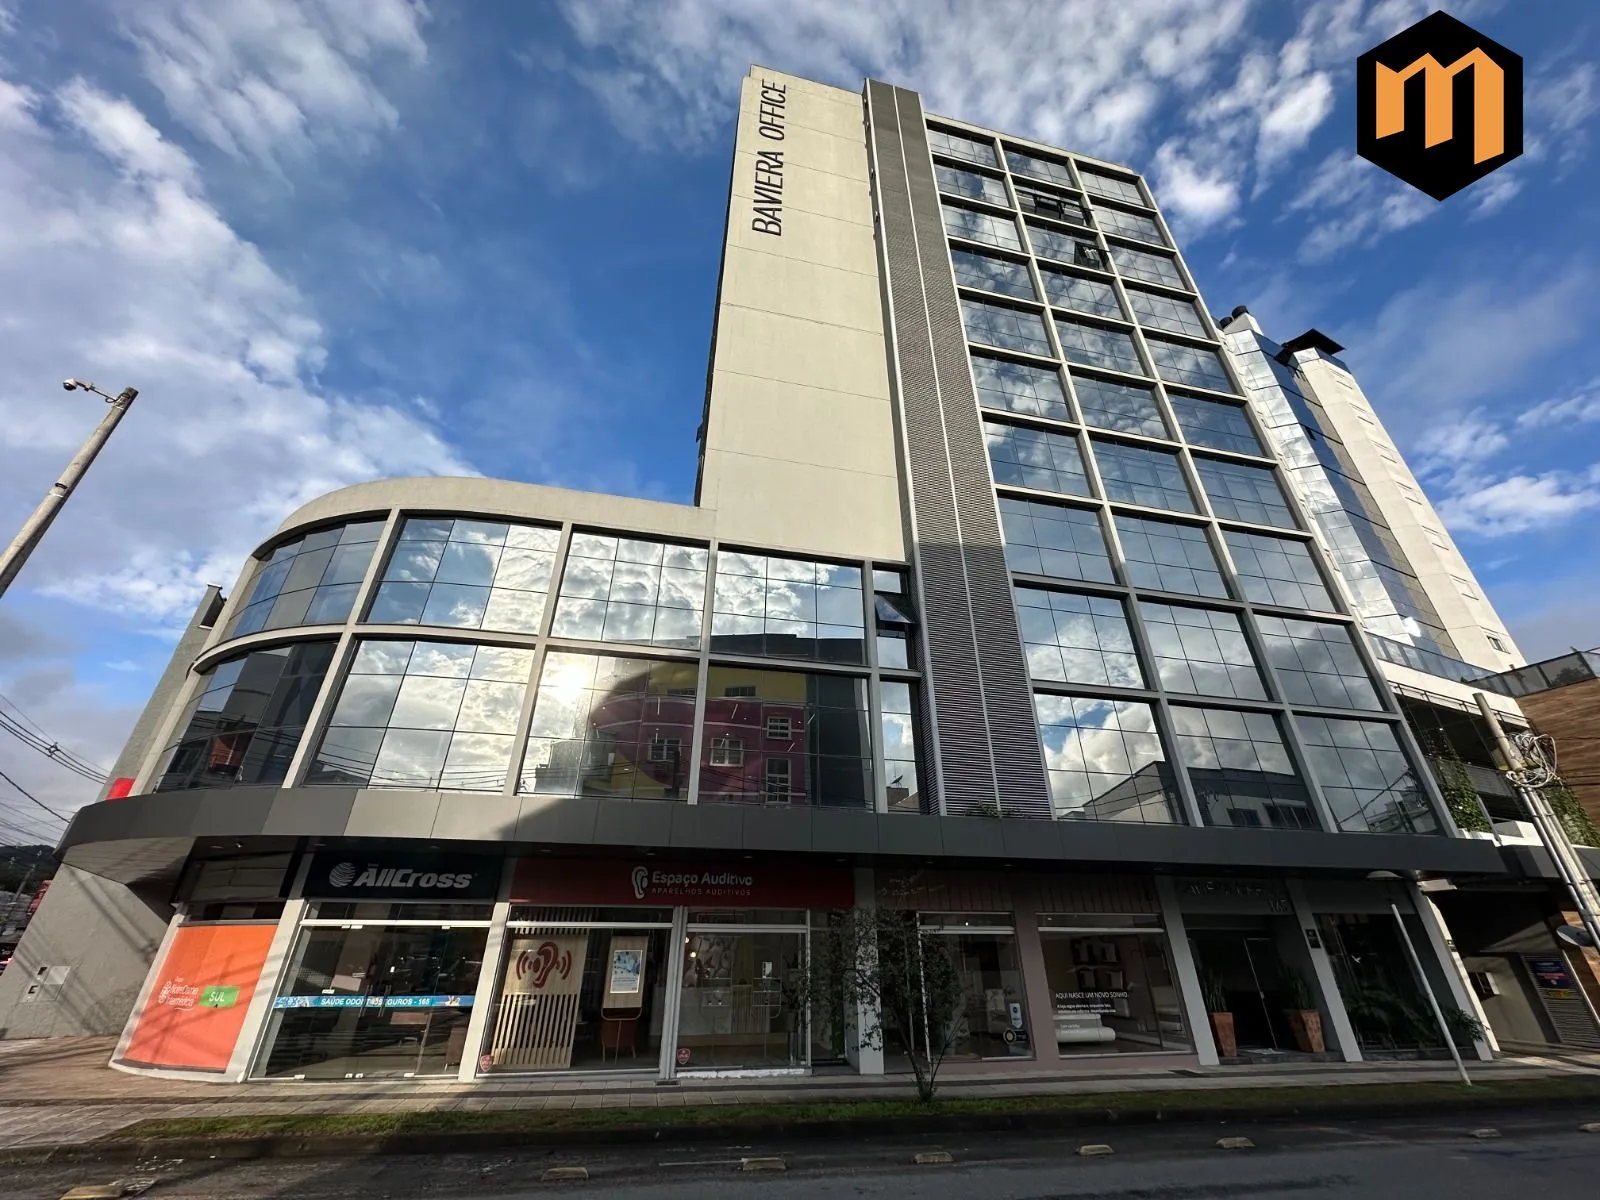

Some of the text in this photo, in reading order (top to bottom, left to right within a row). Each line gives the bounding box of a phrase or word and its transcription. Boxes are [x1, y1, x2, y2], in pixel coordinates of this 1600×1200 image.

[752, 79, 786, 236] BAVIERA OFFICE
[353, 868, 472, 888] AllCross
[652, 871, 752, 887] Espaço Auditivo
[651, 887, 751, 896] APARELHOS AUDITIVOS
[209, 991, 225, 1002] SUL
[320, 996, 344, 1005] SAÚDE
